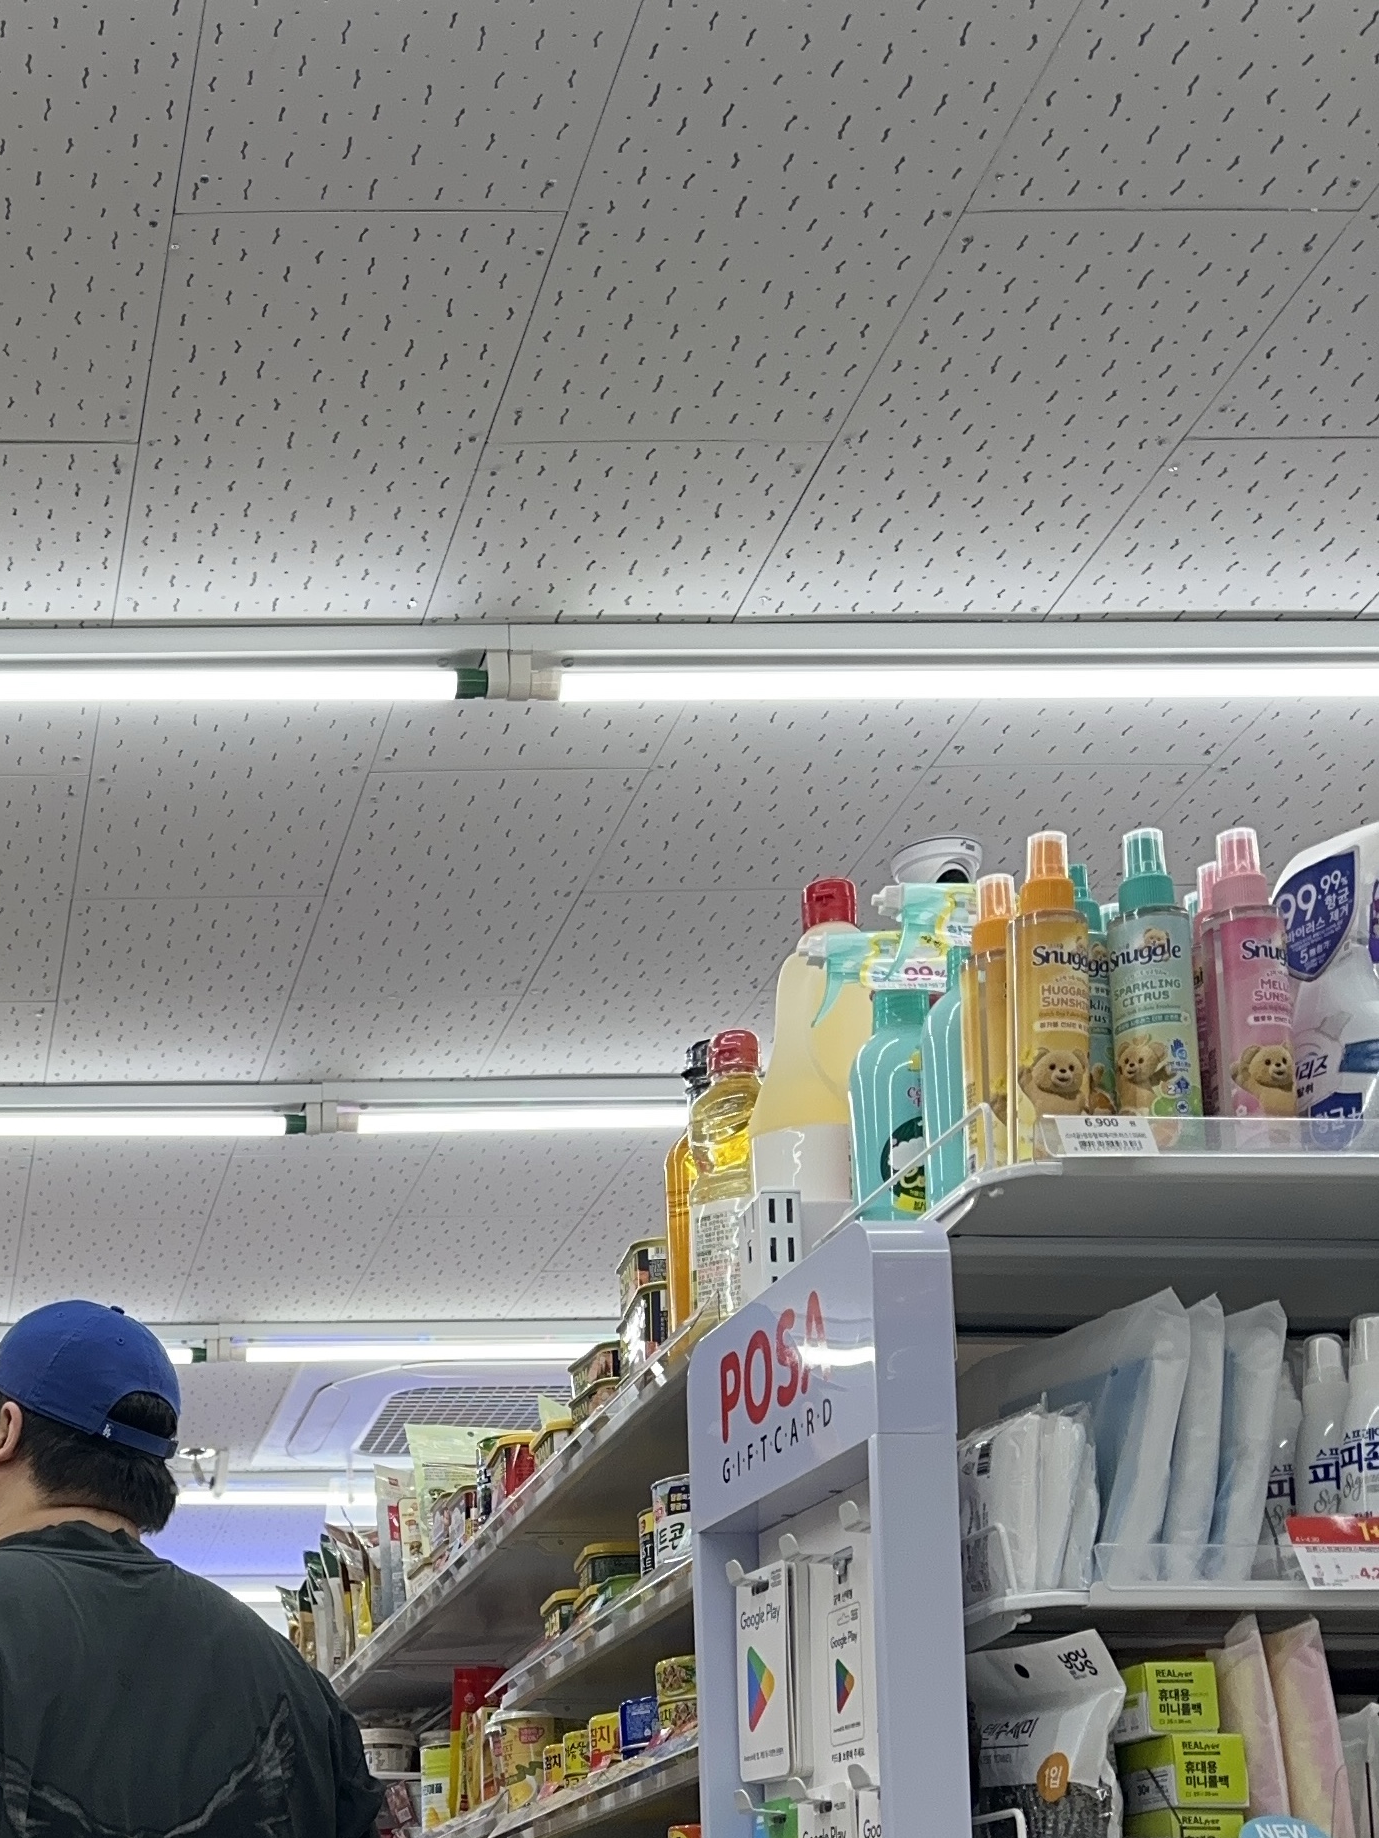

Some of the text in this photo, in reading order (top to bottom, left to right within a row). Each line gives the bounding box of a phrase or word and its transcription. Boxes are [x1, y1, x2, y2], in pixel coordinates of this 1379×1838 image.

[1032, 944, 1088, 974] Snugg
[1110, 938, 1181, 973] Snuggle
[1241, 938, 1286, 966] Snug
[1122, 990, 1170, 1008] CITRUS
[1084, 1117, 1119, 1129] 6,900
[721, 1290, 832, 1445] POSA
[740, 1603, 781, 1631] Google Play
[830, 1629, 858, 1650] Google Play
[1155, 1668, 1178, 1678] REAL
[1157, 1688, 1190, 1702] 휴대용
[981, 1716, 1041, 1741] 텐수세미
[1182, 1740, 1205, 1751] REAL
[545, 1753, 562, 1770] 참치
[1184, 1760, 1217, 1774] 휴대용
[1044, 1765, 1063, 1789] 1입
[1182, 1815, 1206, 1825] REAL
